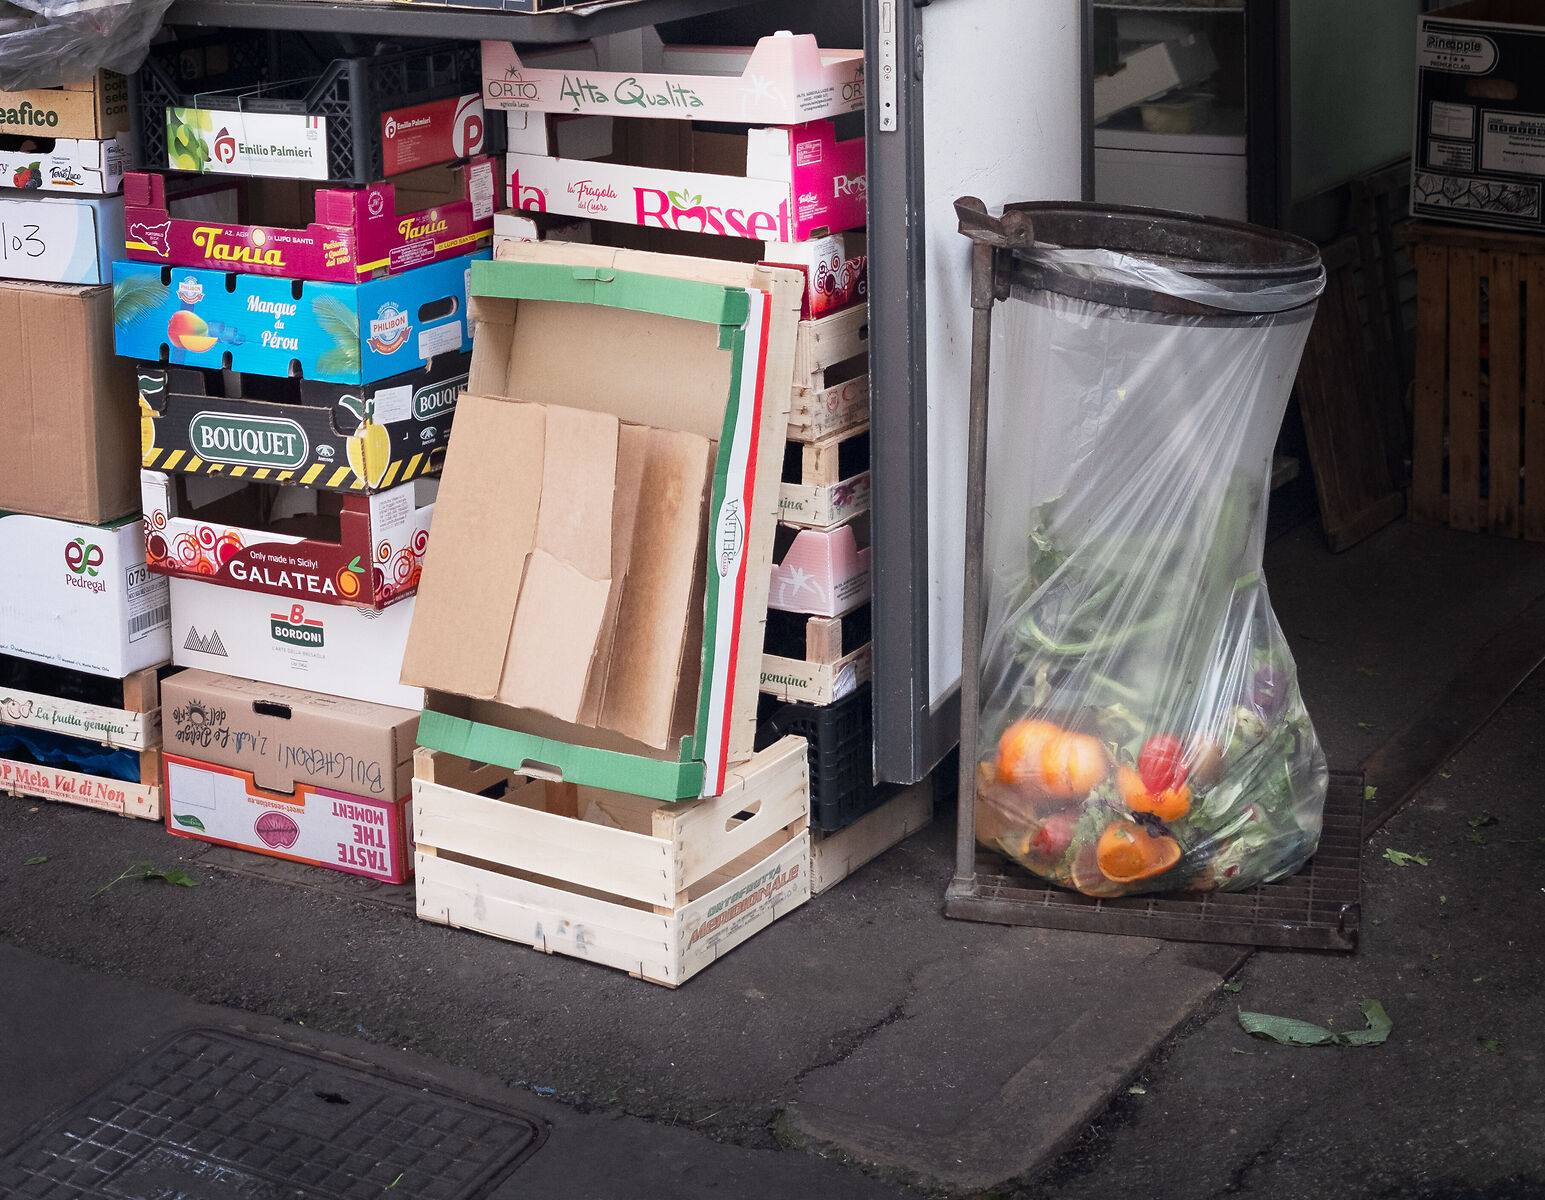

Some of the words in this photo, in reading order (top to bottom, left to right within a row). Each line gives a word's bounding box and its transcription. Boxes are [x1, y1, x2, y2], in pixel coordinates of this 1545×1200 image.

[1426, 35, 1482, 54] Pineapple
[1453, 63, 1471, 71] CLASS
[560, 74, 609, 108] Alta
[614, 77, 704, 109] Qualità
[397, 121, 411, 130] Emilio
[412, 117, 431, 127] Palmieri
[239, 143, 268, 156] Emilio
[270, 145, 312, 158] Palmieri
[574, 180, 618, 201] Fragola
[587, 199, 608, 214] Cuore
[398, 214, 449, 241] Tania
[192, 227, 287, 267] Tania
[293, 237, 314, 245] SANTO
[247, 295, 297, 319] Mangue
[274, 320, 285, 329] du
[373, 316, 406, 333] PHILIBON
[261, 330, 299, 350] Pérou
[420, 382, 468, 413] BOUQU
[200, 425, 297, 457] BOUQUET
[250, 551, 266, 563] Only
[267, 553, 287, 564] made
[288, 556, 296, 565] in
[297, 558, 319, 569] Sicily!
[66, 574, 107, 594] Pedregal
[229, 560, 338, 597] GALATEA
[290, 604, 305, 624] B
[274, 626, 322, 643] BORDONI
[760, 671, 808, 689] genuina
[35, 707, 49, 720] La
[51, 710, 81, 727] frutta
[176, 726, 213, 748] Delizie
[213, 726, 230, 748] Le
[278, 743, 384, 794] BULGHERONI
[15, 766, 49, 789] Mela
[55, 774, 76, 793] Val
[79, 779, 92, 797] di
[95, 783, 126, 804] Non
[248, 797, 305, 815] sweet-sensation.eu
[332, 802, 384, 826] MOMENT
[352, 824, 386, 849] THE
[337, 843, 388, 872] TASTE
